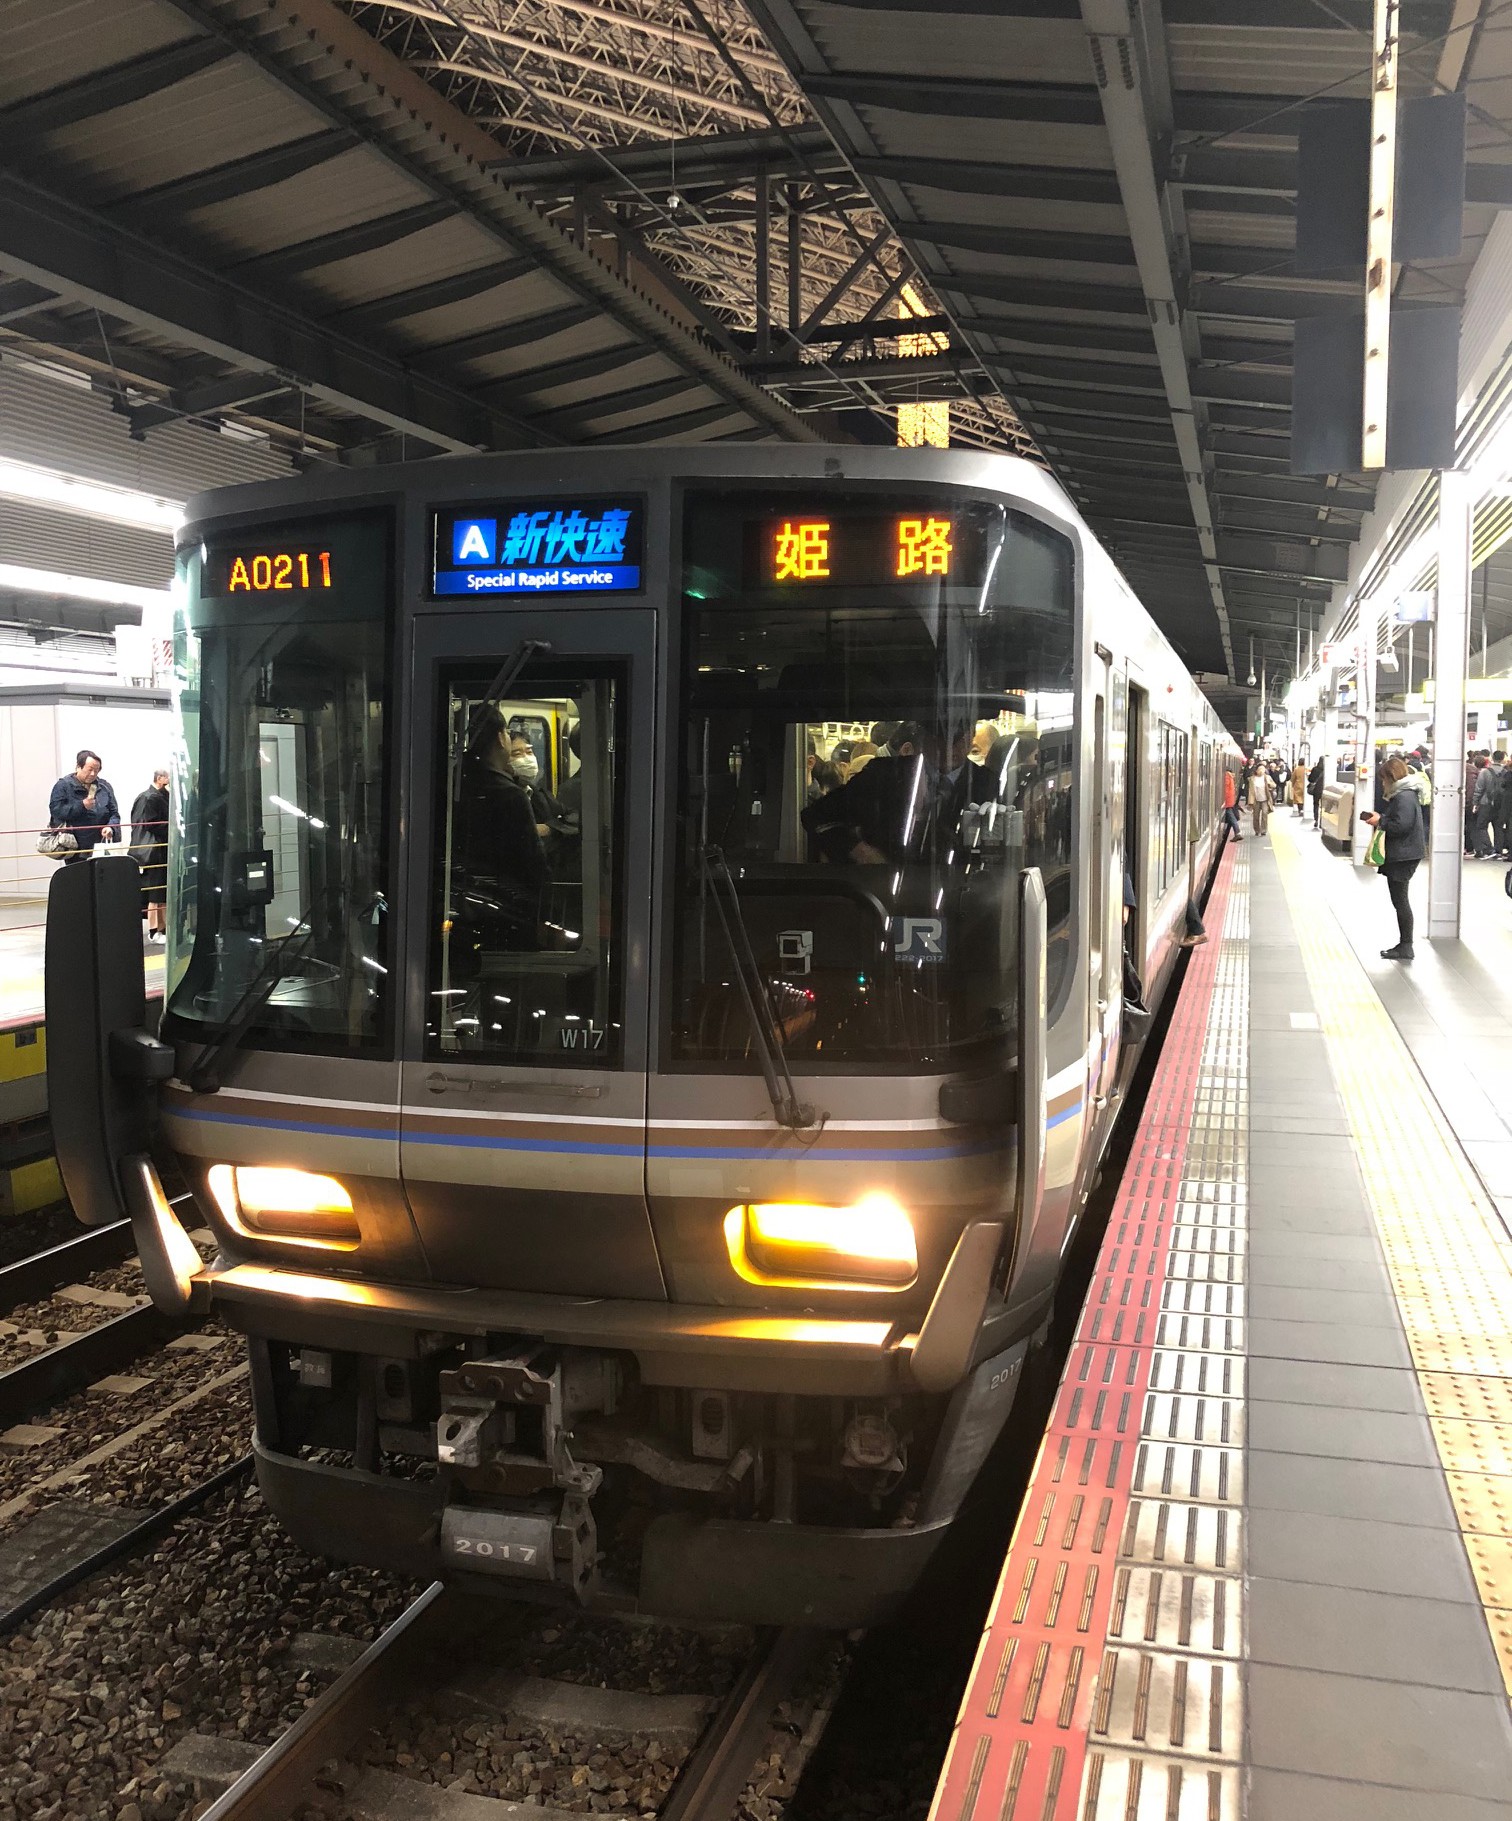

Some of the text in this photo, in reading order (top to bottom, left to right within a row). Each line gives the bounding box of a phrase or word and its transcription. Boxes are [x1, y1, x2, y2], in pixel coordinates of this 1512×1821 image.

[459, 508, 632, 565] A 新快速
[229, 552, 331, 592] A0211
[467, 569, 613, 590] Special Rapid Service
[895, 918, 942, 953] JR
[561, 1029, 604, 1049] W17
[991, 1357, 1022, 1390] 2017
[456, 1539, 535, 1562] 2017
